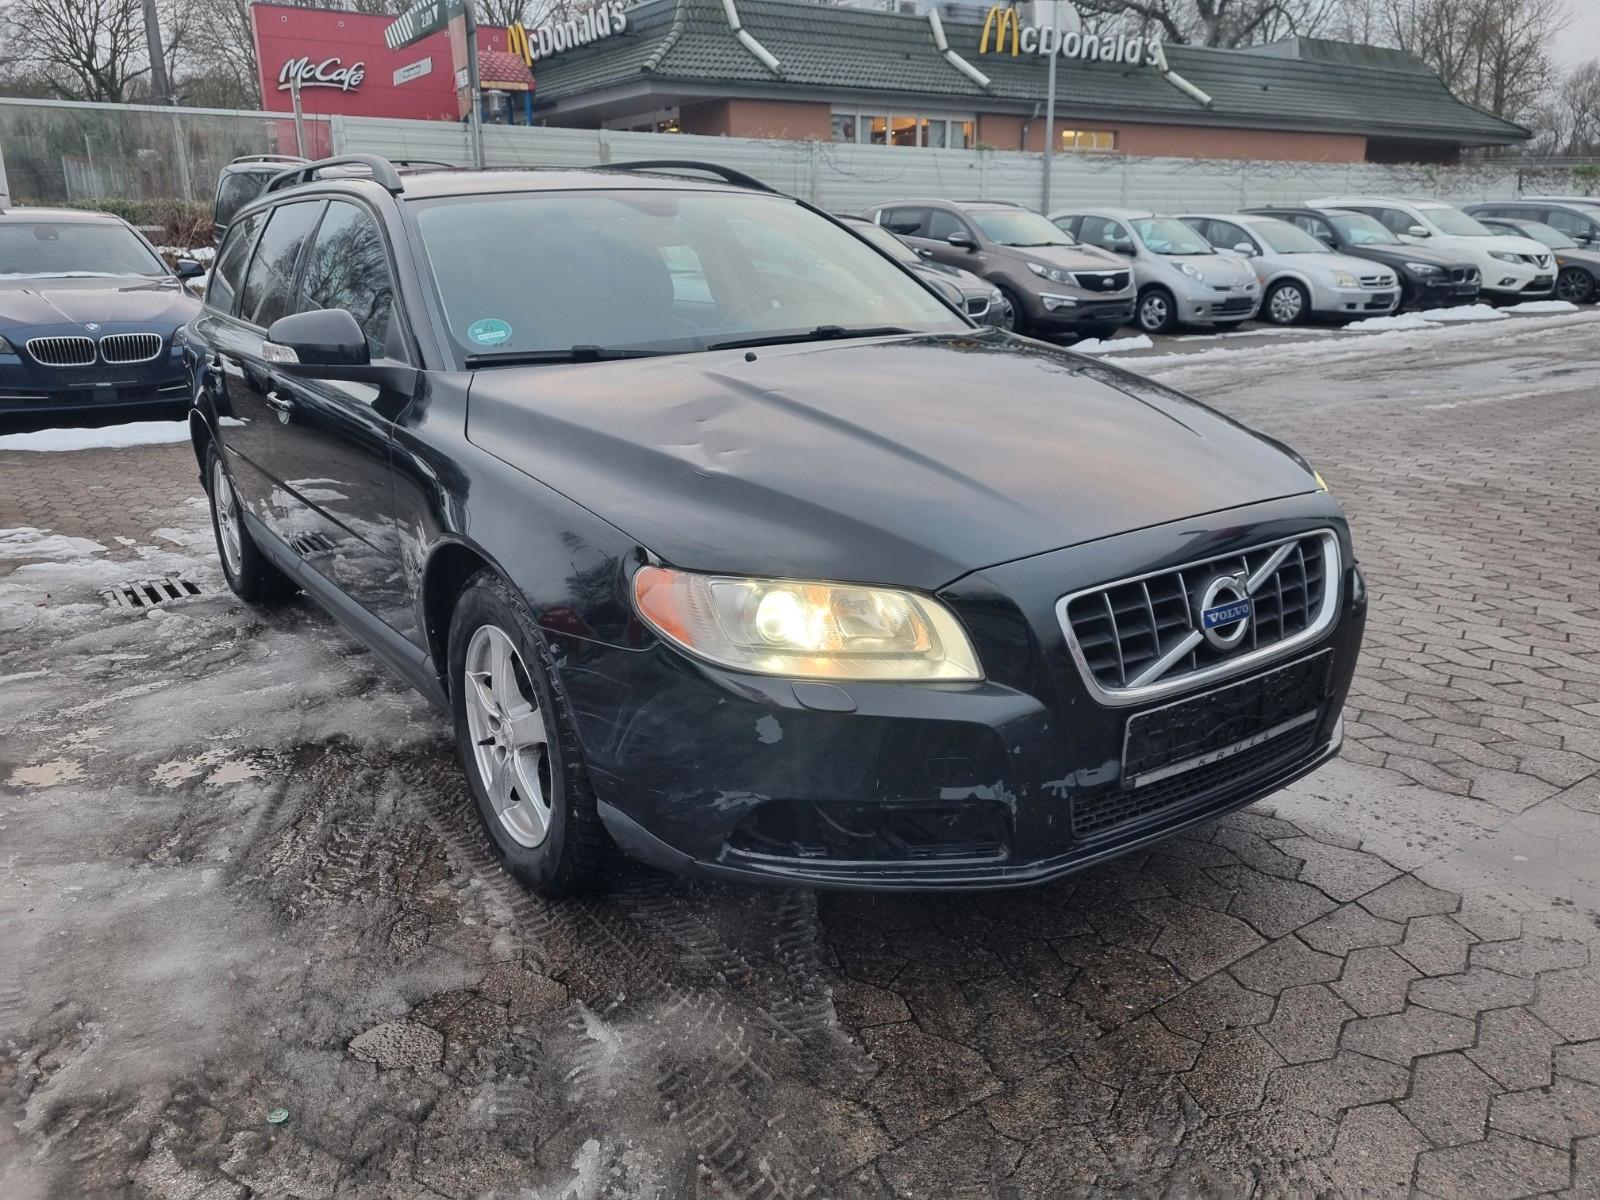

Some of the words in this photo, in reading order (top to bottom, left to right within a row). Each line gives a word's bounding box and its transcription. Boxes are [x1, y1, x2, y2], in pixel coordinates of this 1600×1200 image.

[508, 1, 627, 67] McDonald's
[980, 5, 1160, 66] McDonald's
[1207, 603, 1249, 623] VOLVO
